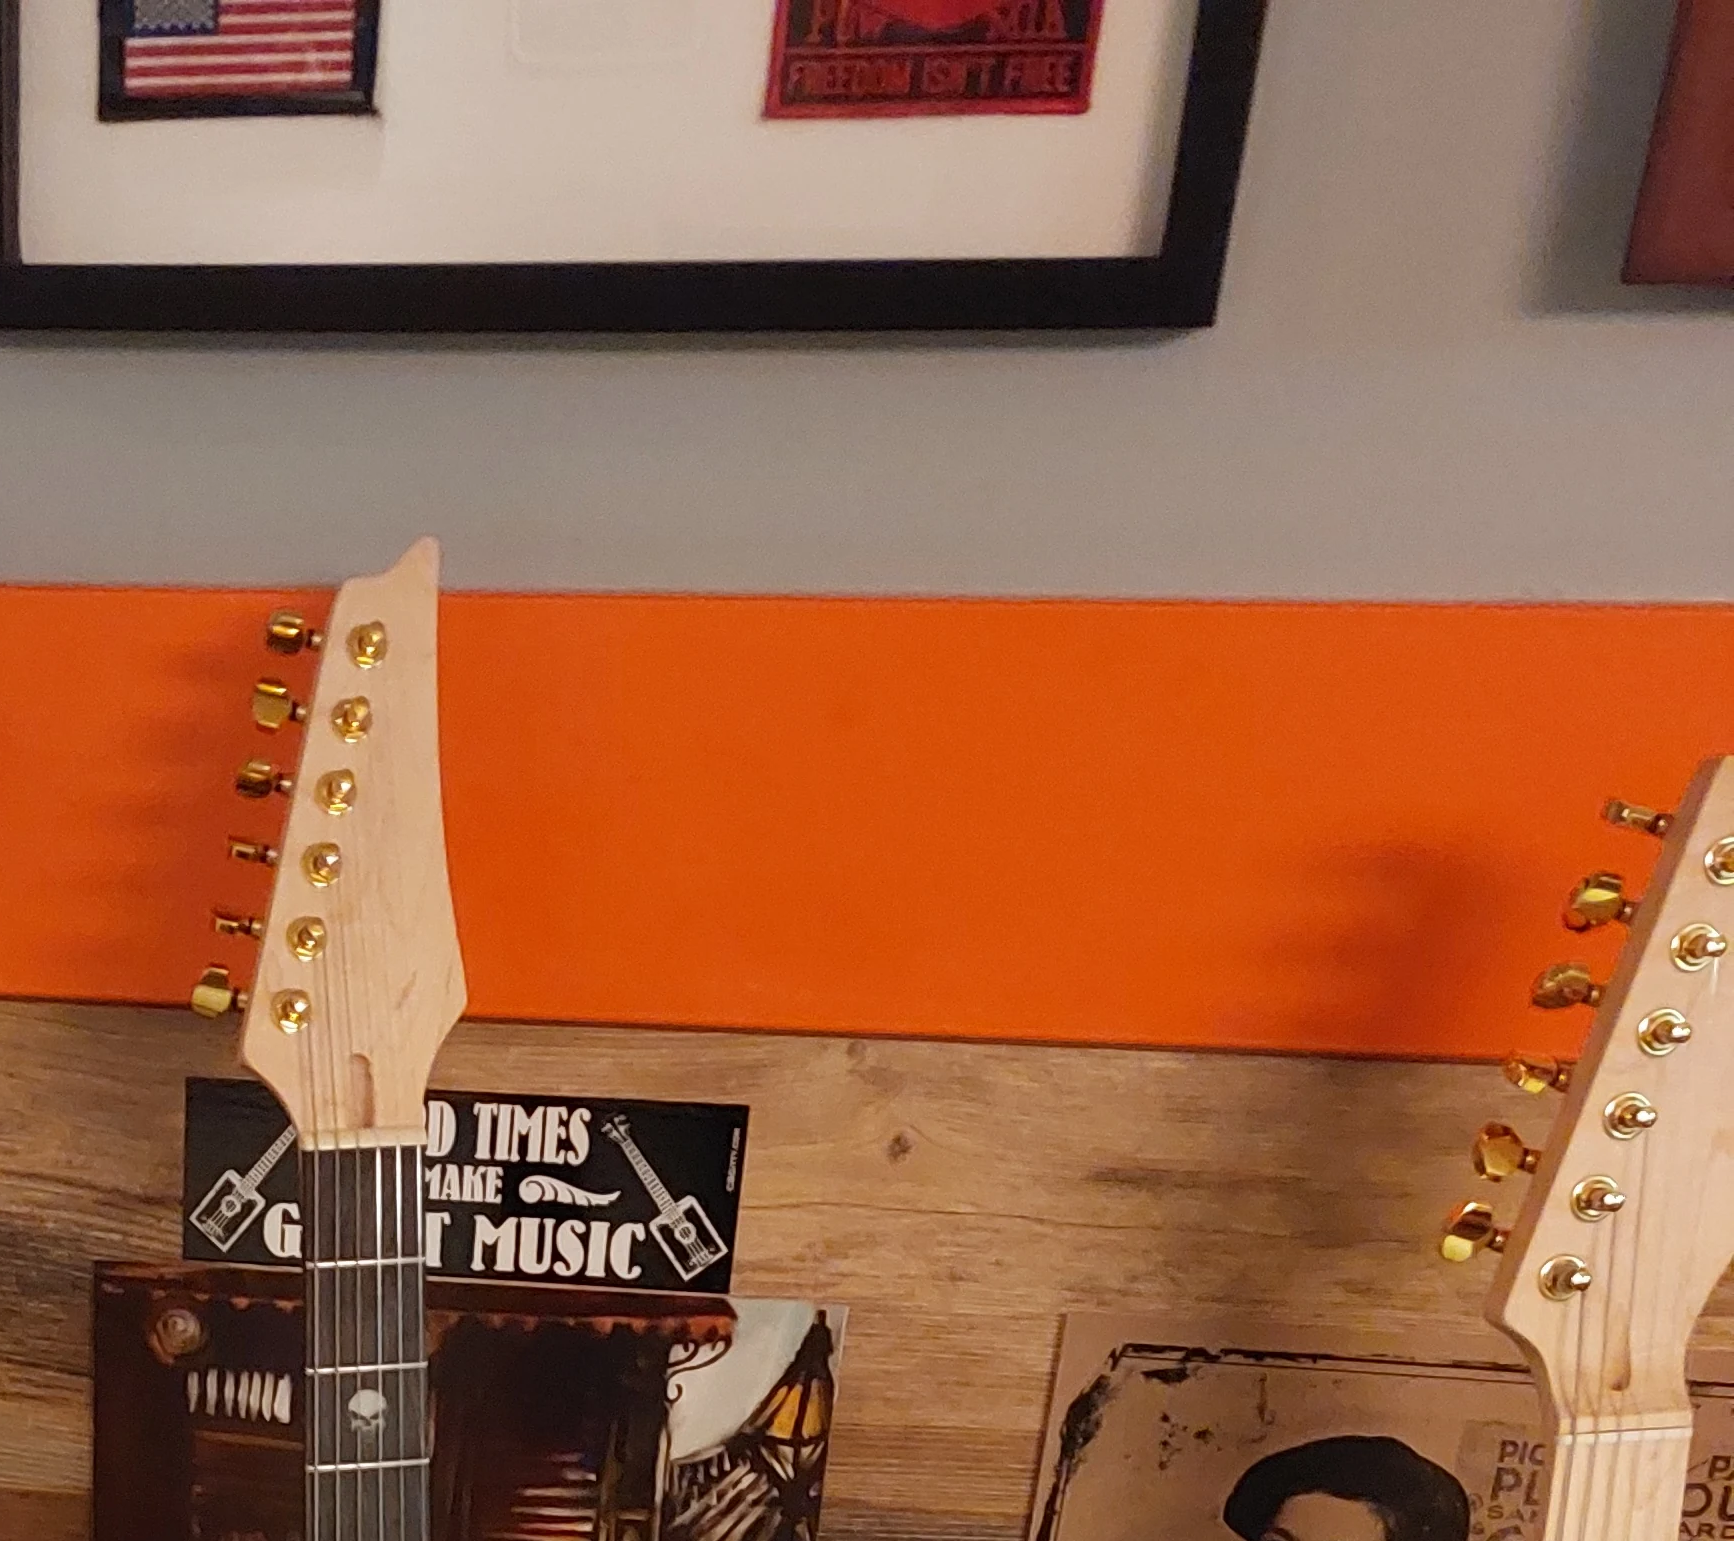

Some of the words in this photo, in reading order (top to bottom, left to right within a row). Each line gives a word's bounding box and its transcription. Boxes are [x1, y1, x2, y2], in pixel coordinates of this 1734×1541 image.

[1003, 56, 1073, 93] FREE
[473, 1101, 593, 1167] TIMES
[470, 1214, 647, 1281] MUSIC
